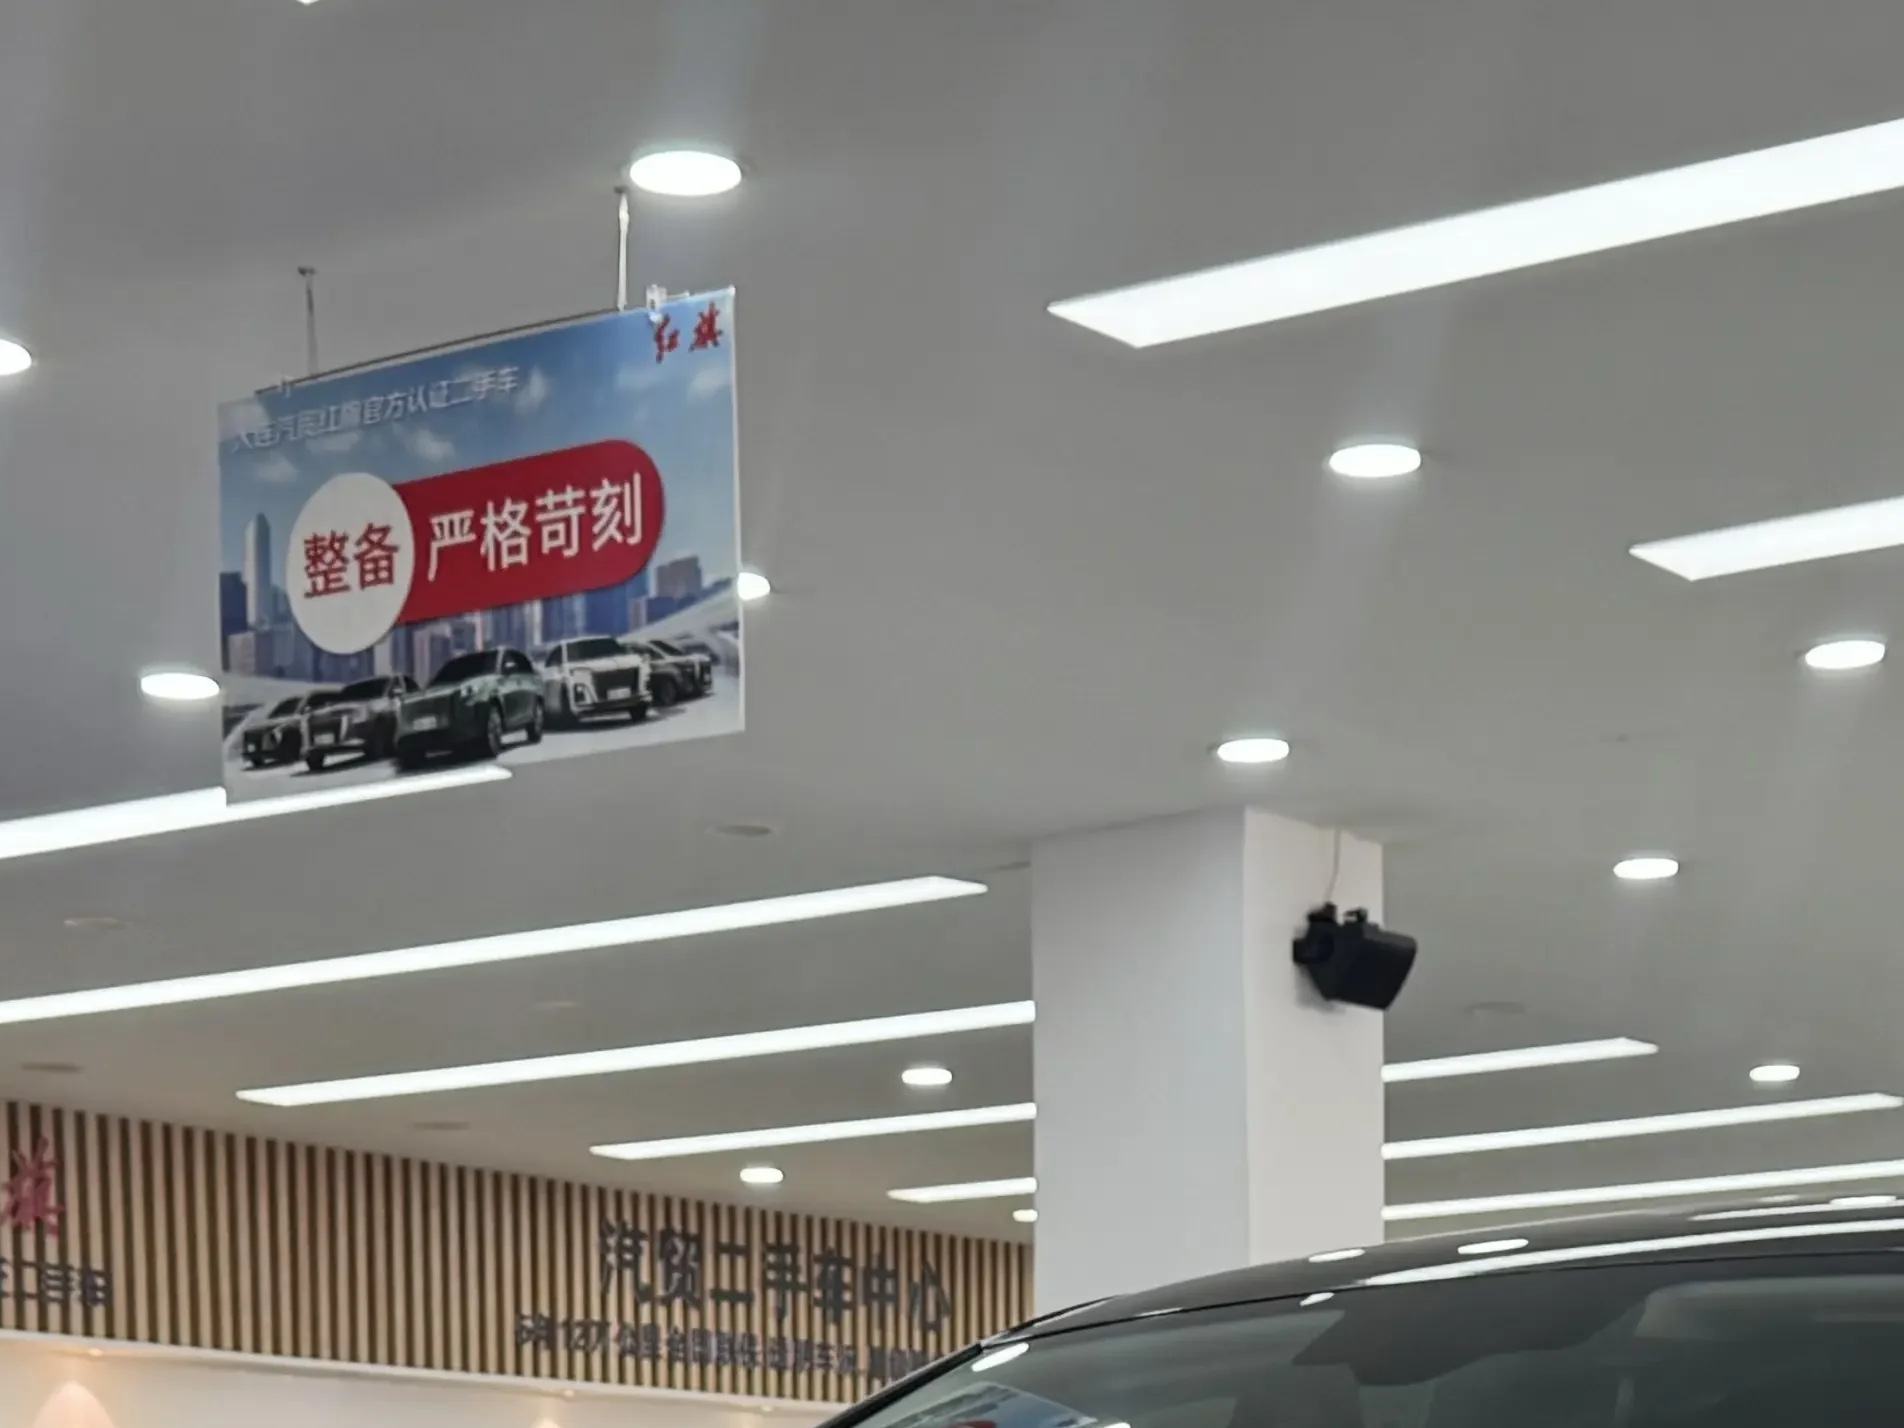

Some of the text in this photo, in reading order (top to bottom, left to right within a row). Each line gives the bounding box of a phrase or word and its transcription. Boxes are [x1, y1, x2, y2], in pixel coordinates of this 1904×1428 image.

[303, 471, 642, 599] 整备 严格苛刻
[600, 1219, 951, 1333] 汽贸二手车中心
